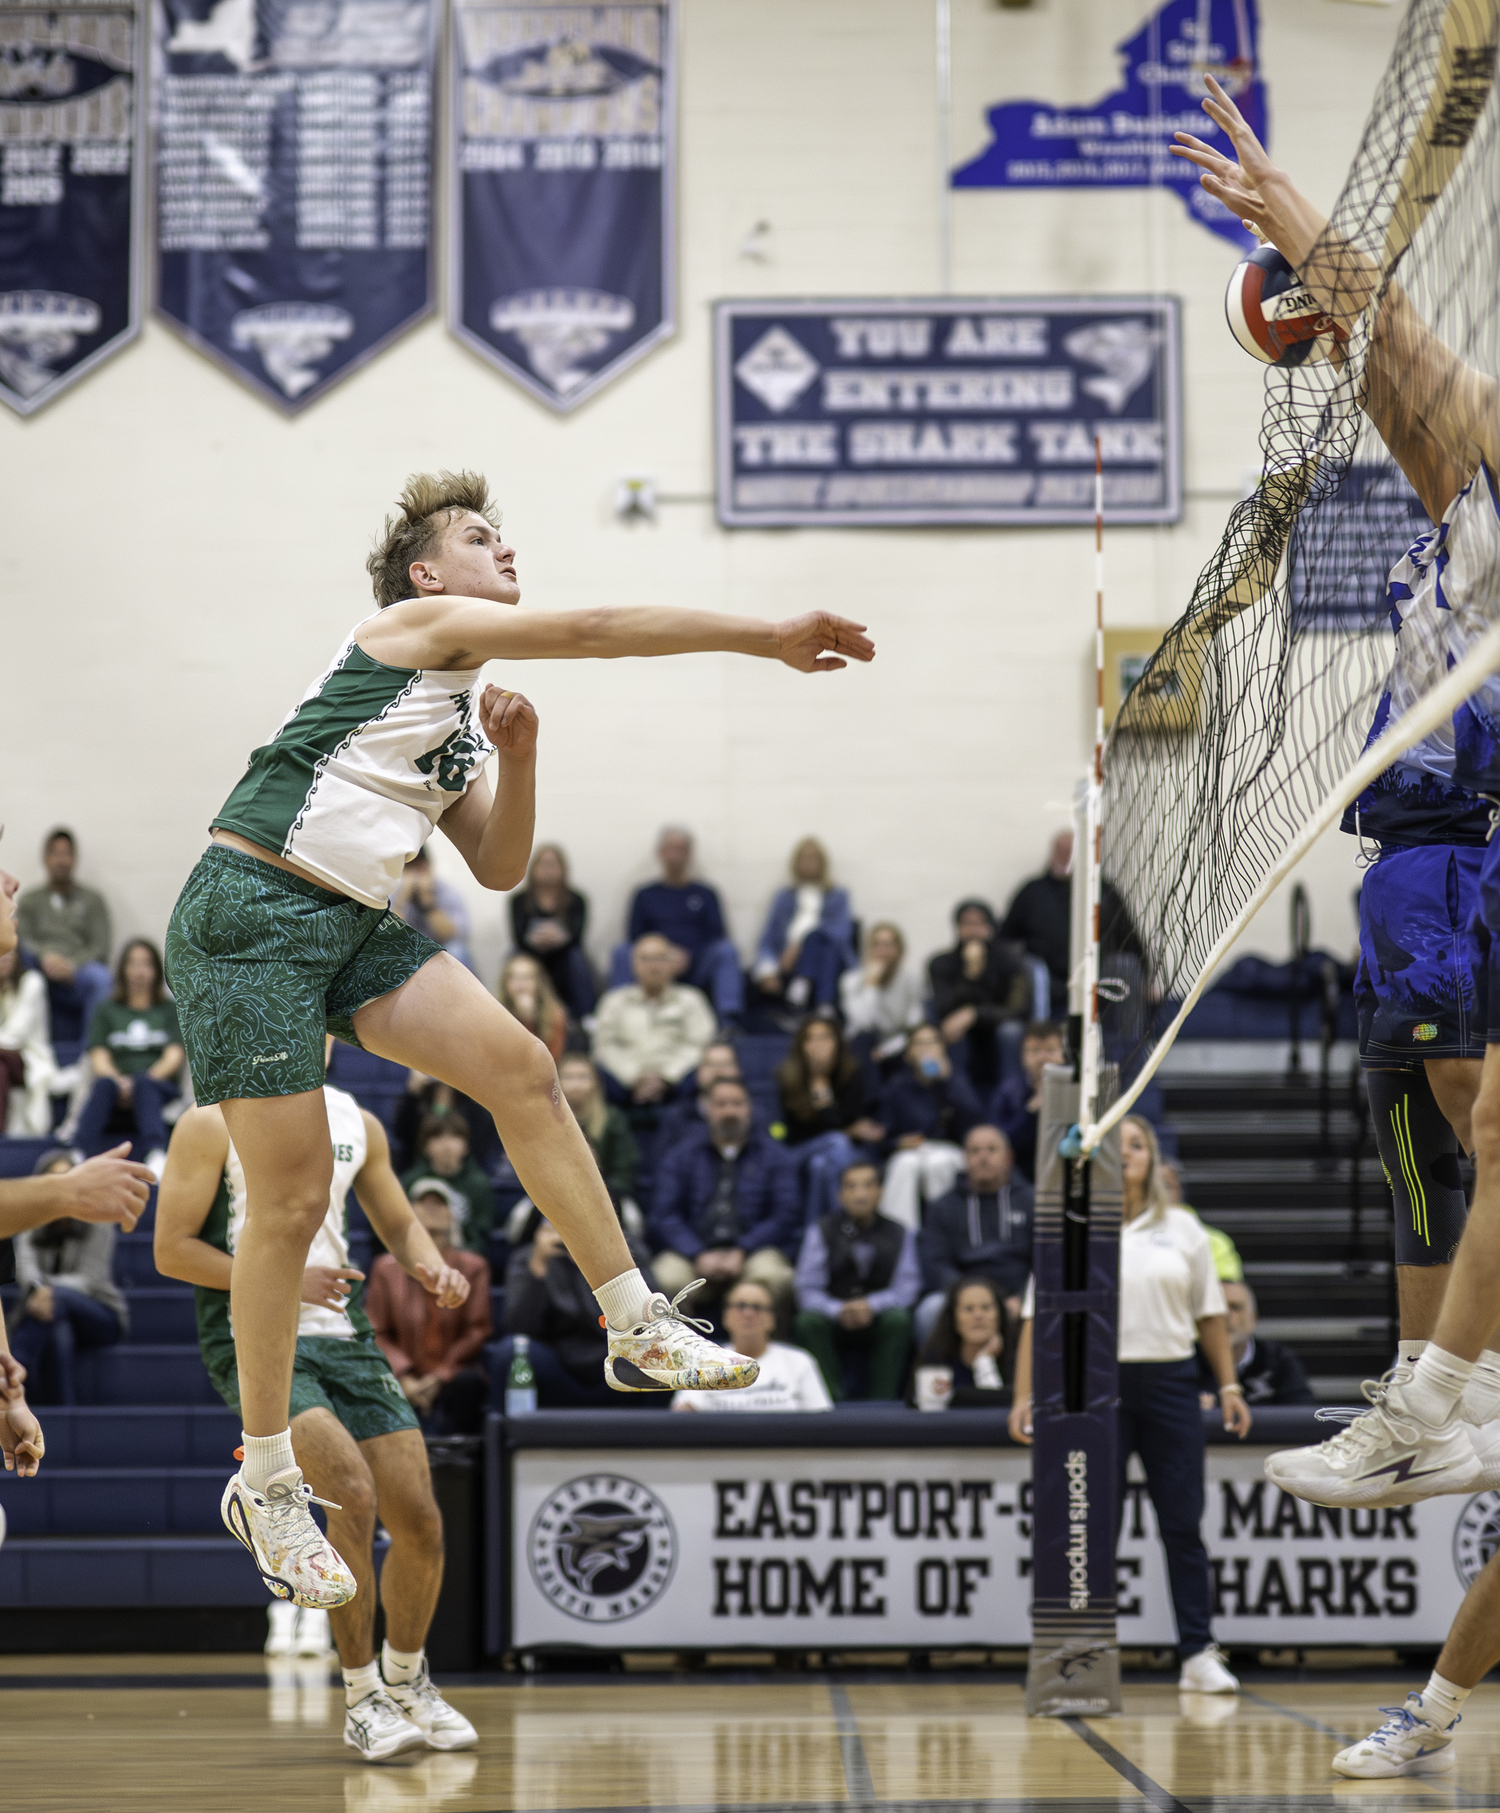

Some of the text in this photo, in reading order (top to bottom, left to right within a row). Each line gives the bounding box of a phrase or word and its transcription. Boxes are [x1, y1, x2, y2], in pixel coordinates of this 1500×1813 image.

[830, 317, 1049, 358] YOU ARE
[823, 368, 1075, 411] ENTERING
[735, 422, 1164, 465] THE SHARK TANK
[1064, 1449, 1091, 1611] sports imports
[1220, 1479, 1417, 1539] MANOR
[712, 1557, 888, 1617] HOME
[915, 1557, 991, 1617] OF
[1209, 1557, 1417, 1617] HARKS
